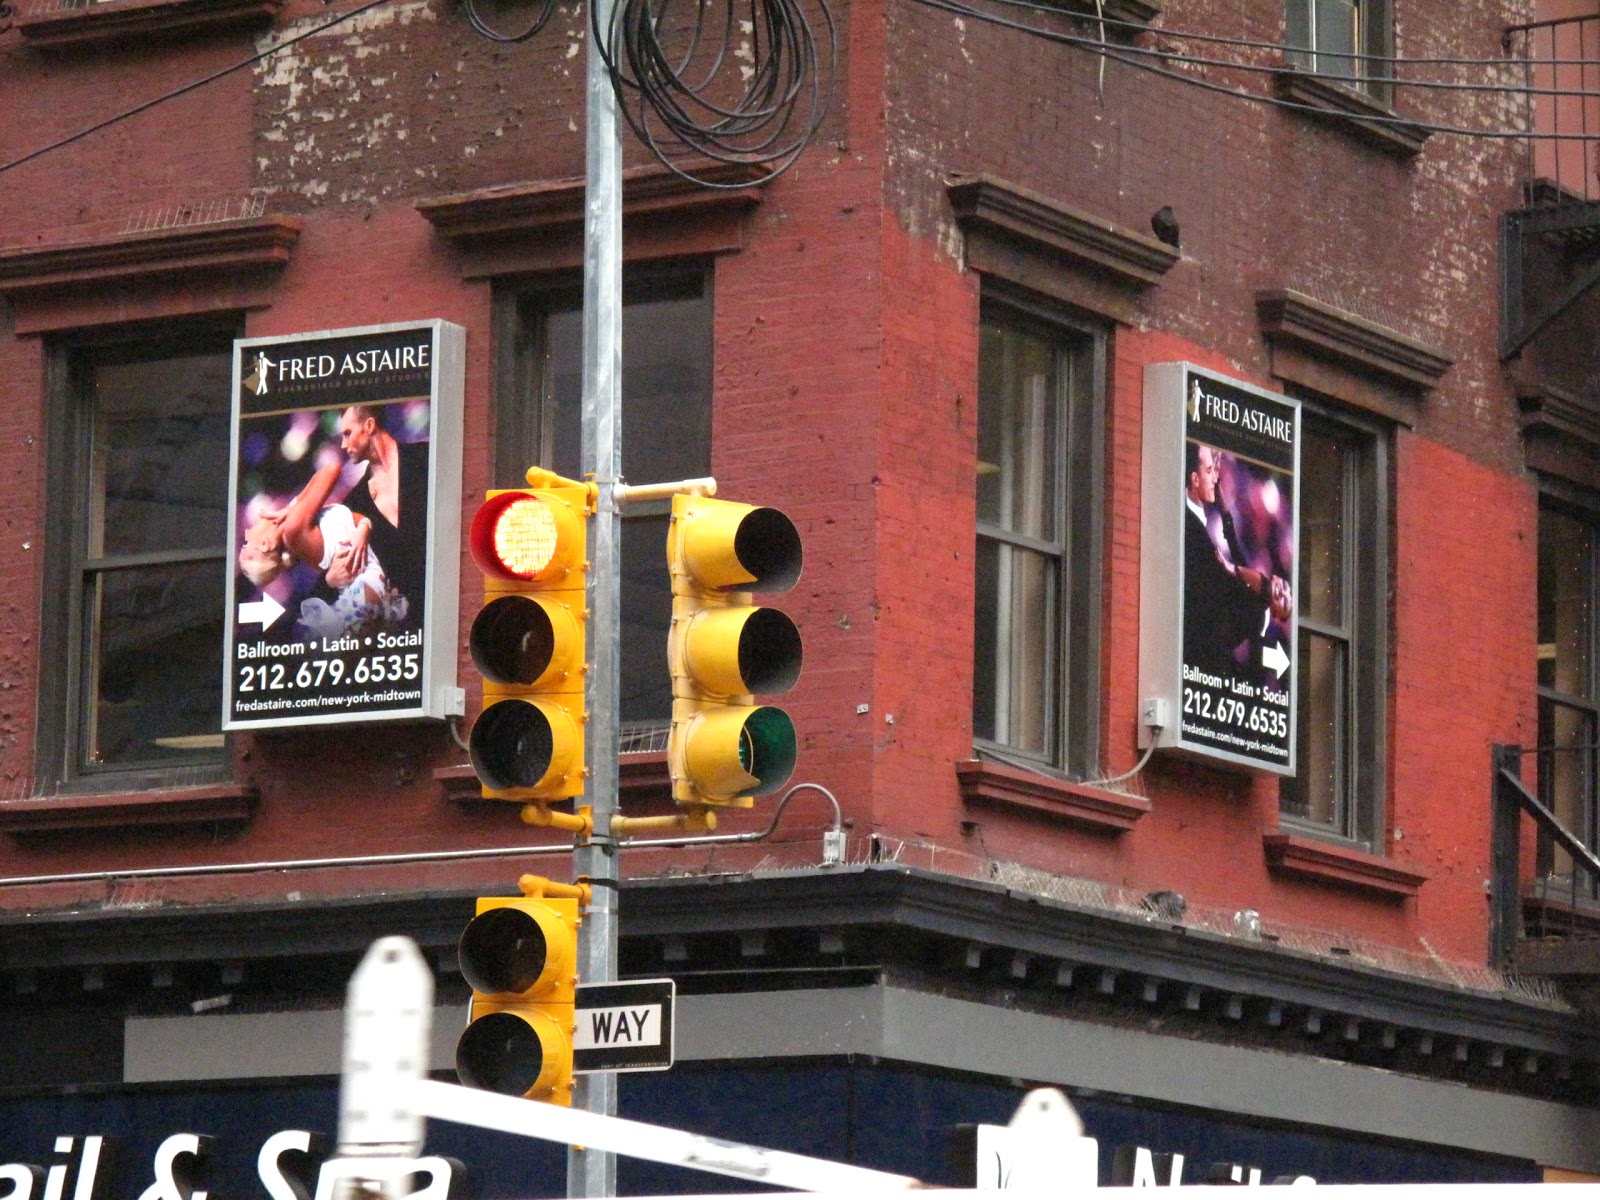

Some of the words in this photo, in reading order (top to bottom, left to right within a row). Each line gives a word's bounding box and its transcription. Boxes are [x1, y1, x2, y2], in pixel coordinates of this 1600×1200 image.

[278, 355, 335, 381] FRED
[340, 344, 430, 375] ASTAIRE
[1206, 394, 1240, 424] FRED
[1241, 408, 1292, 443] ASTAIRE
[237, 641, 305, 659] Ballroom
[322, 636, 359, 652] Latin
[377, 629, 422, 648] Social
[239, 654, 419, 692] 212.679.6535
[1182, 664, 1223, 689] Ballroom
[1232, 677, 1254, 697] Latin
[1262, 686, 1289, 707] Social
[235, 689, 421, 712] fredastaire.com/new-york-midtown
[1184, 687, 1287, 738] 212.679.6535
[1182, 720, 1289, 758] fredastaire.com/new-york-midtown
[592, 1009, 650, 1044] WAY
[0, 1136, 103, 1200] il
